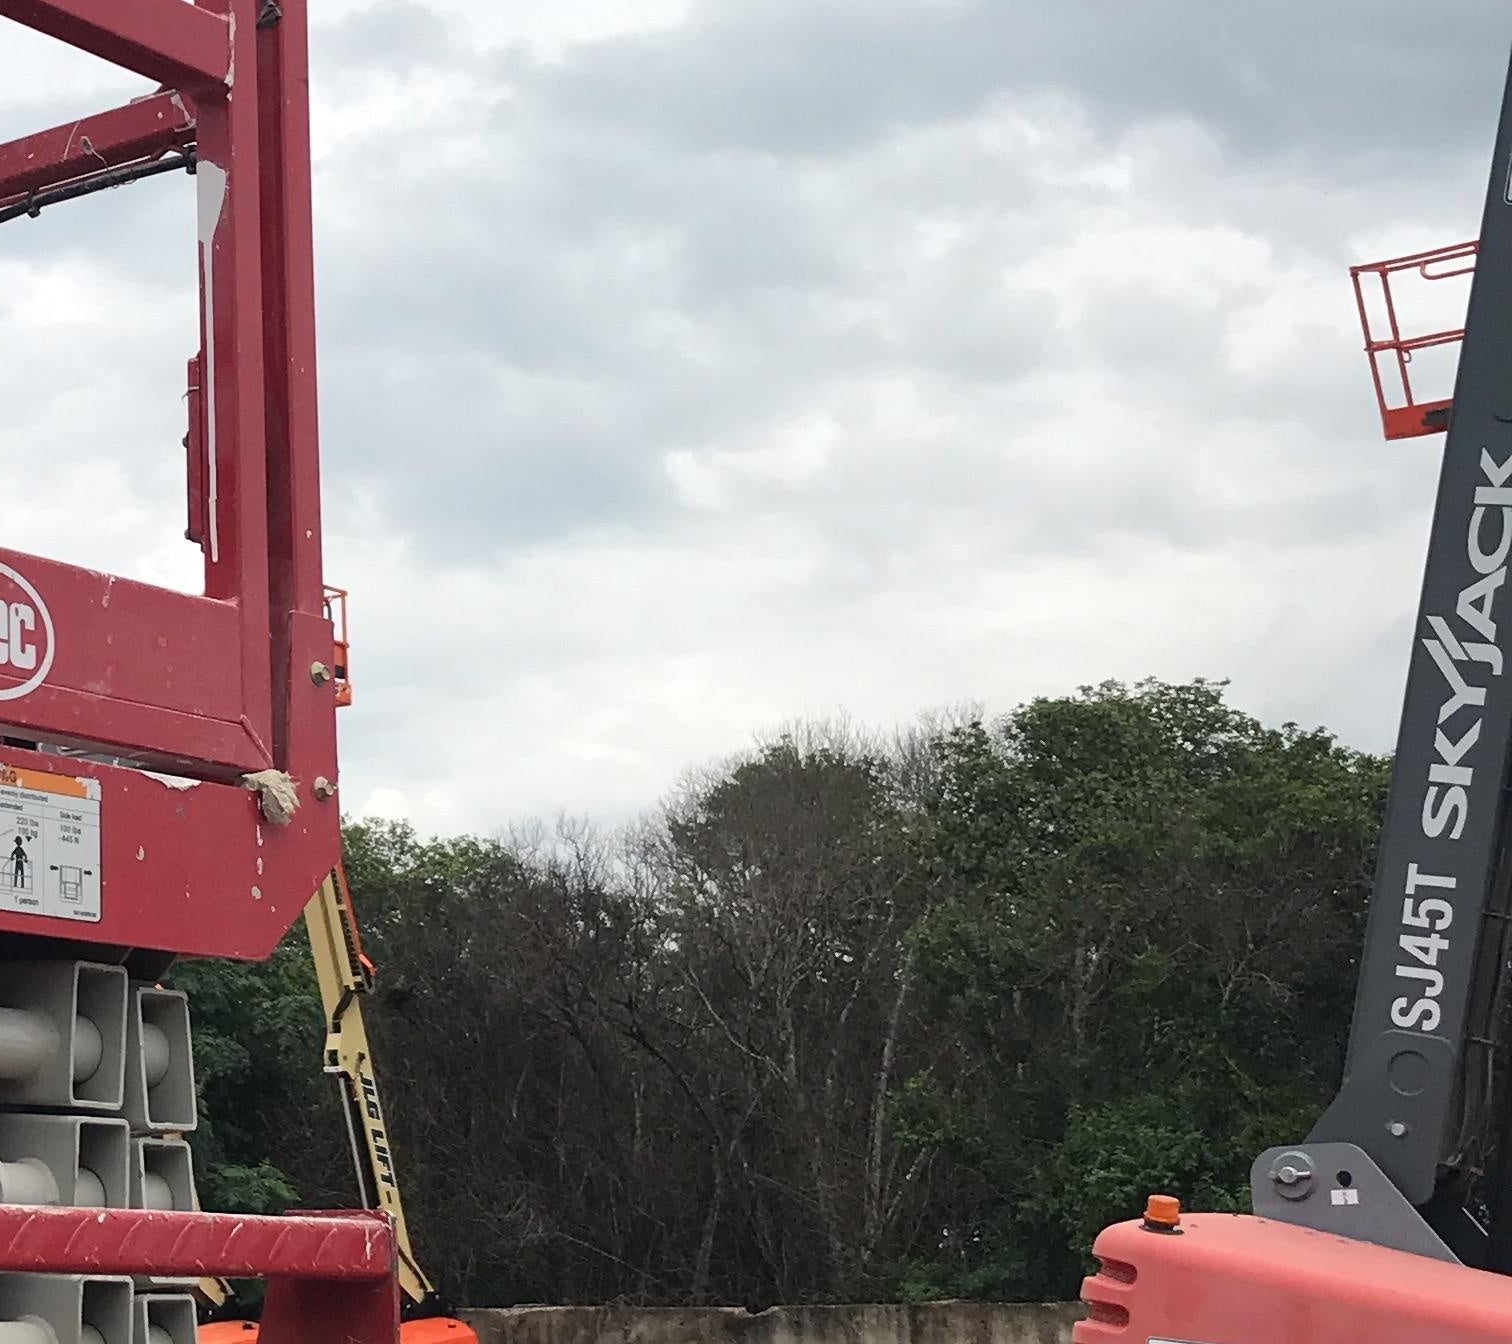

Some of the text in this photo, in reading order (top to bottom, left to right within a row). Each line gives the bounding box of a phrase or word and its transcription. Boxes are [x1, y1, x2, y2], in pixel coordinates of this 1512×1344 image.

[1390, 862, 1456, 1032] SJ45T
[360, 1072, 395, 1188] JLG LIFT
